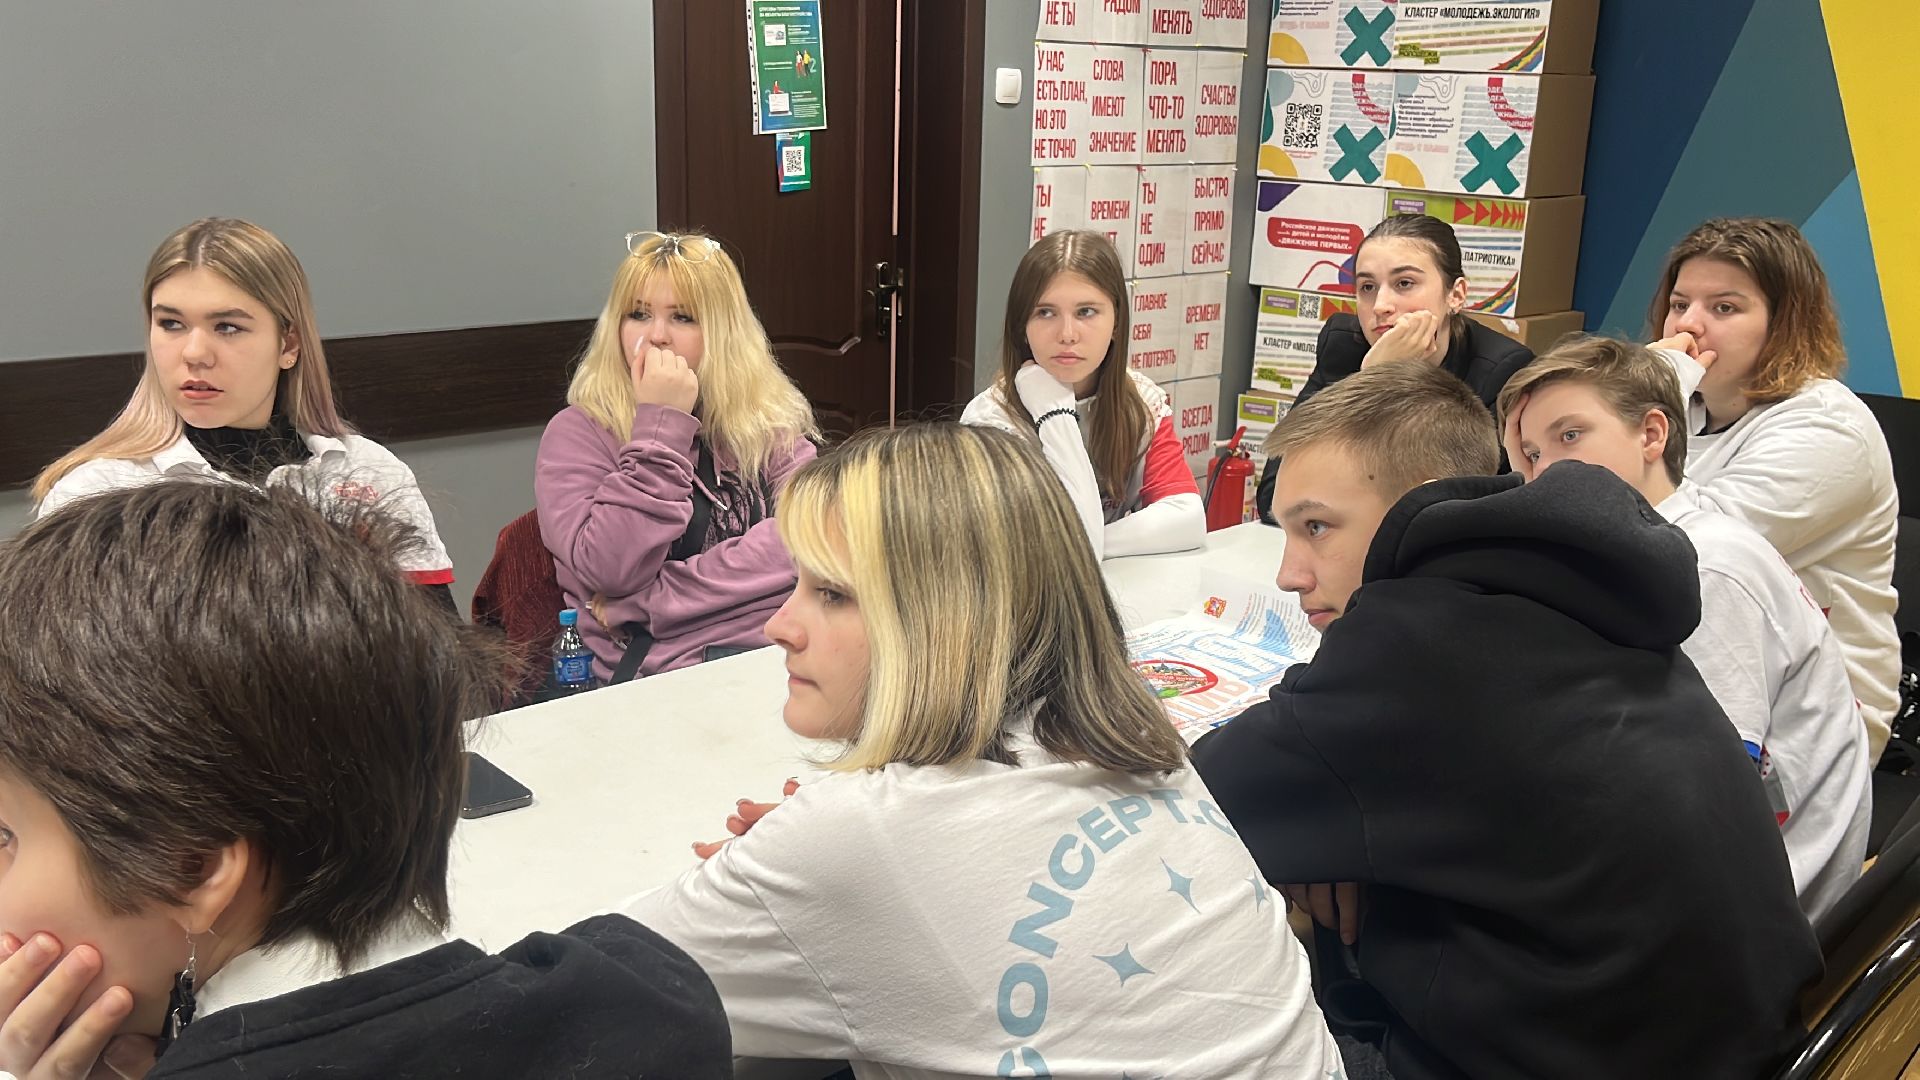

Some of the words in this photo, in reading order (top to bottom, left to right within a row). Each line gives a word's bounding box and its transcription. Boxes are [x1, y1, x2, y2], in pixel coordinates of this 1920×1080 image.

[1045, 1, 1059, 26] НЕ
[1061, 2, 1076, 26] ТЫ
[1152, 9, 1193, 35] МЕНЯТЬ
[1404, 7, 1438, 18] КЛАСТЕР
[1037, 50, 1045, 72] У
[1046, 50, 1065, 73] НАС
[1093, 59, 1124, 81] СЛОВА
[1150, 61, 1177, 85] ПОРА
[1036, 80, 1058, 101] ЕСТЬ
[1060, 80, 1087, 104] ПЛАН,
[1201, 84, 1237, 106] СЧАСТЬЯ
[1092, 96, 1125, 117] ИМЕЮТ
[1149, 95, 1184, 120] ЧТО-ТО
[1035, 109, 1048, 130] НО
[1050, 109, 1066, 130] ЭТО
[1195, 115, 1237, 138] ЗДОРОВЬЯ
[1034, 138, 1046, 159] НЕ
[1047, 138, 1076, 159] ТОЧНО
[1089, 131, 1137, 153] ЗНАЧЕНИЕ
[1146, 130, 1186, 154] МЕНЯТЬ
[1036, 184, 1052, 208] ТЫ
[1142, 182, 1157, 205] ТЫ
[1194, 176, 1229, 199] БЫСТРО
[1091, 200, 1130, 221] ВРЕМЕНИ
[1194, 210, 1225, 232] ПРЯМО
[1033, 217, 1046, 240] НЕ
[1140, 213, 1153, 235] НЕ
[1138, 242, 1166, 267] ОДИН
[1191, 240, 1225, 266] СЕЙЧАС
[1134, 293, 1168, 313] ГЛАВНОЕ
[1185, 303, 1221, 324] ВРЕМЕНИ
[1132, 323, 1152, 341] СЕБЯ
[1193, 332, 1210, 351] НЕТ
[1262, 336, 1292, 350] КЛАСТЕР
[1131, 352, 1141, 369] НЕ
[1142, 348, 1177, 368] ПОТЕРЯТЬ
[1181, 404, 1213, 429] ВСЕГДА
[1182, 431, 1210, 456] РЯДОМ
